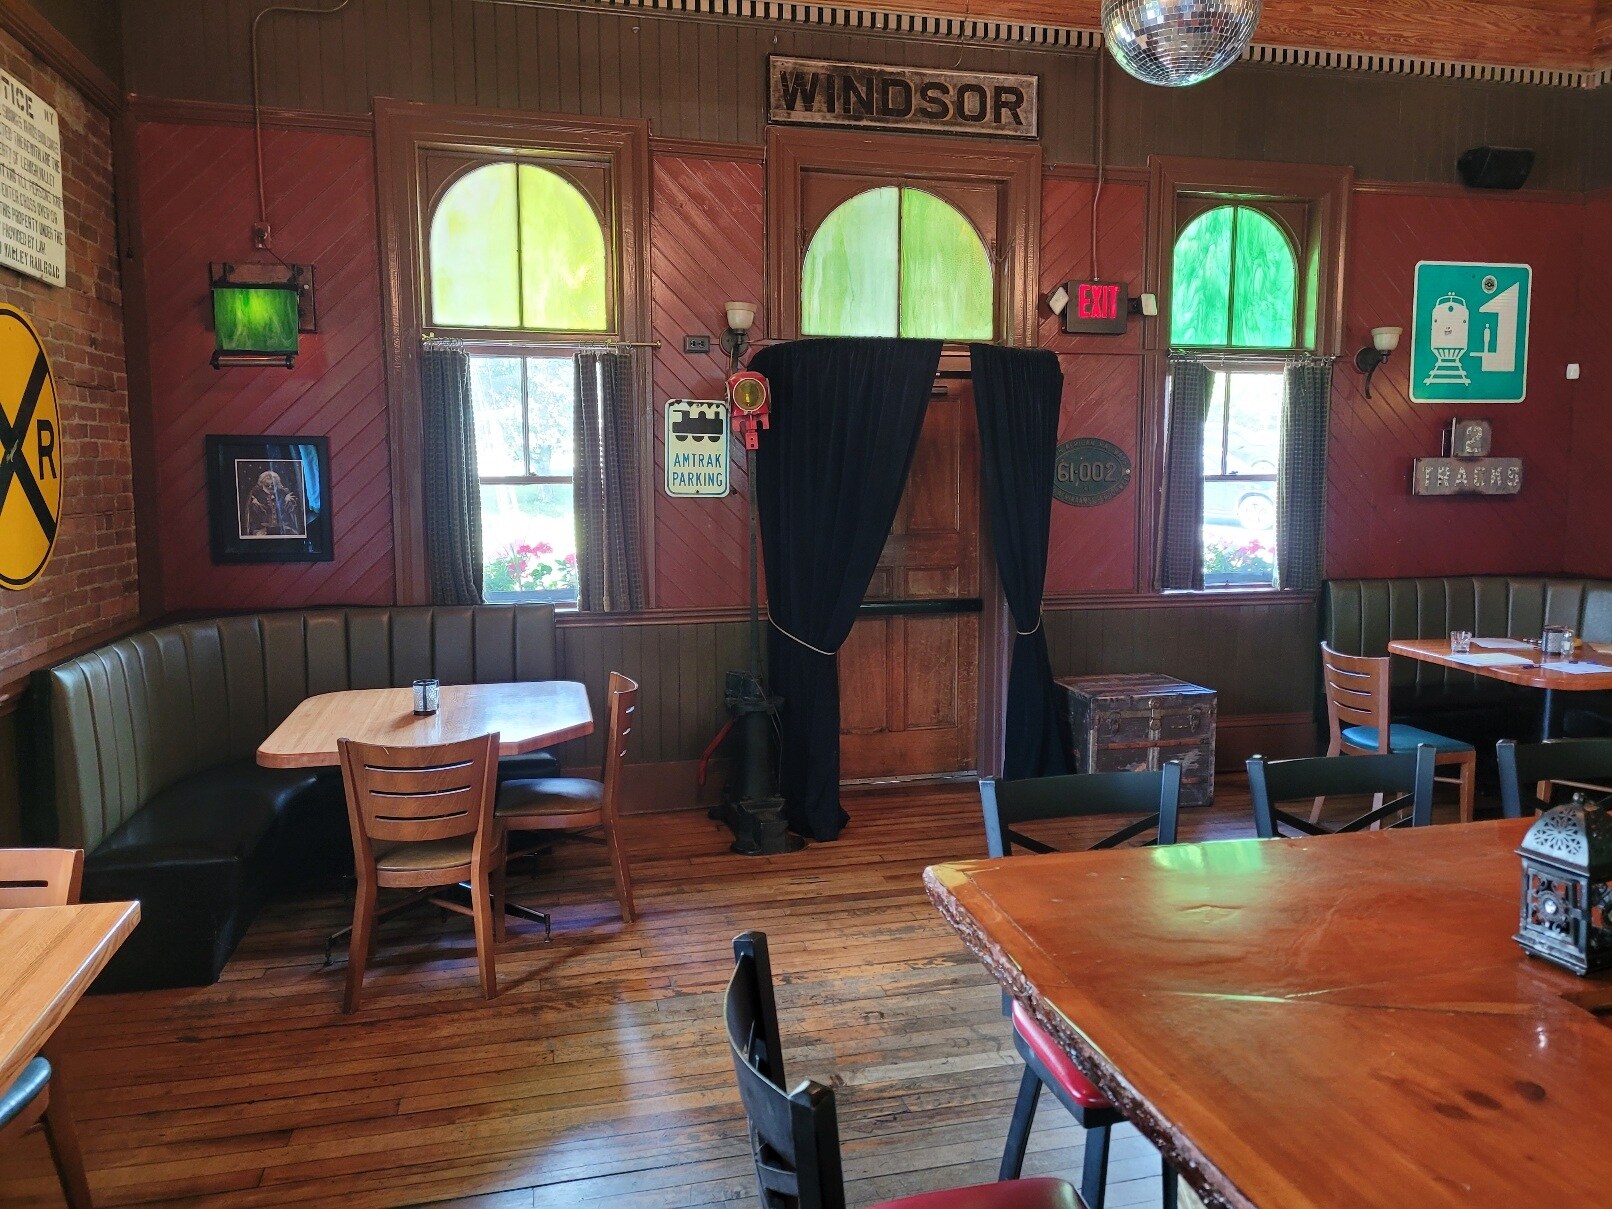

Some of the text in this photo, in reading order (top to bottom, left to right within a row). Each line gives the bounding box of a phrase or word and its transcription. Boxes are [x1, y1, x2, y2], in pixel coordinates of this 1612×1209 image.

[779, 70, 1025, 126] WINDSOR
[11, 207, 37, 232] PROPERTY
[3, 243, 28, 266] VALLEY
[29, 253, 59, 278] RAILROAD
[1078, 284, 1119, 319] EXIT
[37, 419, 57, 480] R
[1466, 426, 1482, 453] 2
[673, 452, 721, 468] AMTRAK
[672, 471, 723, 487] PARKING
[1422, 466, 1520, 487] TRACKS
